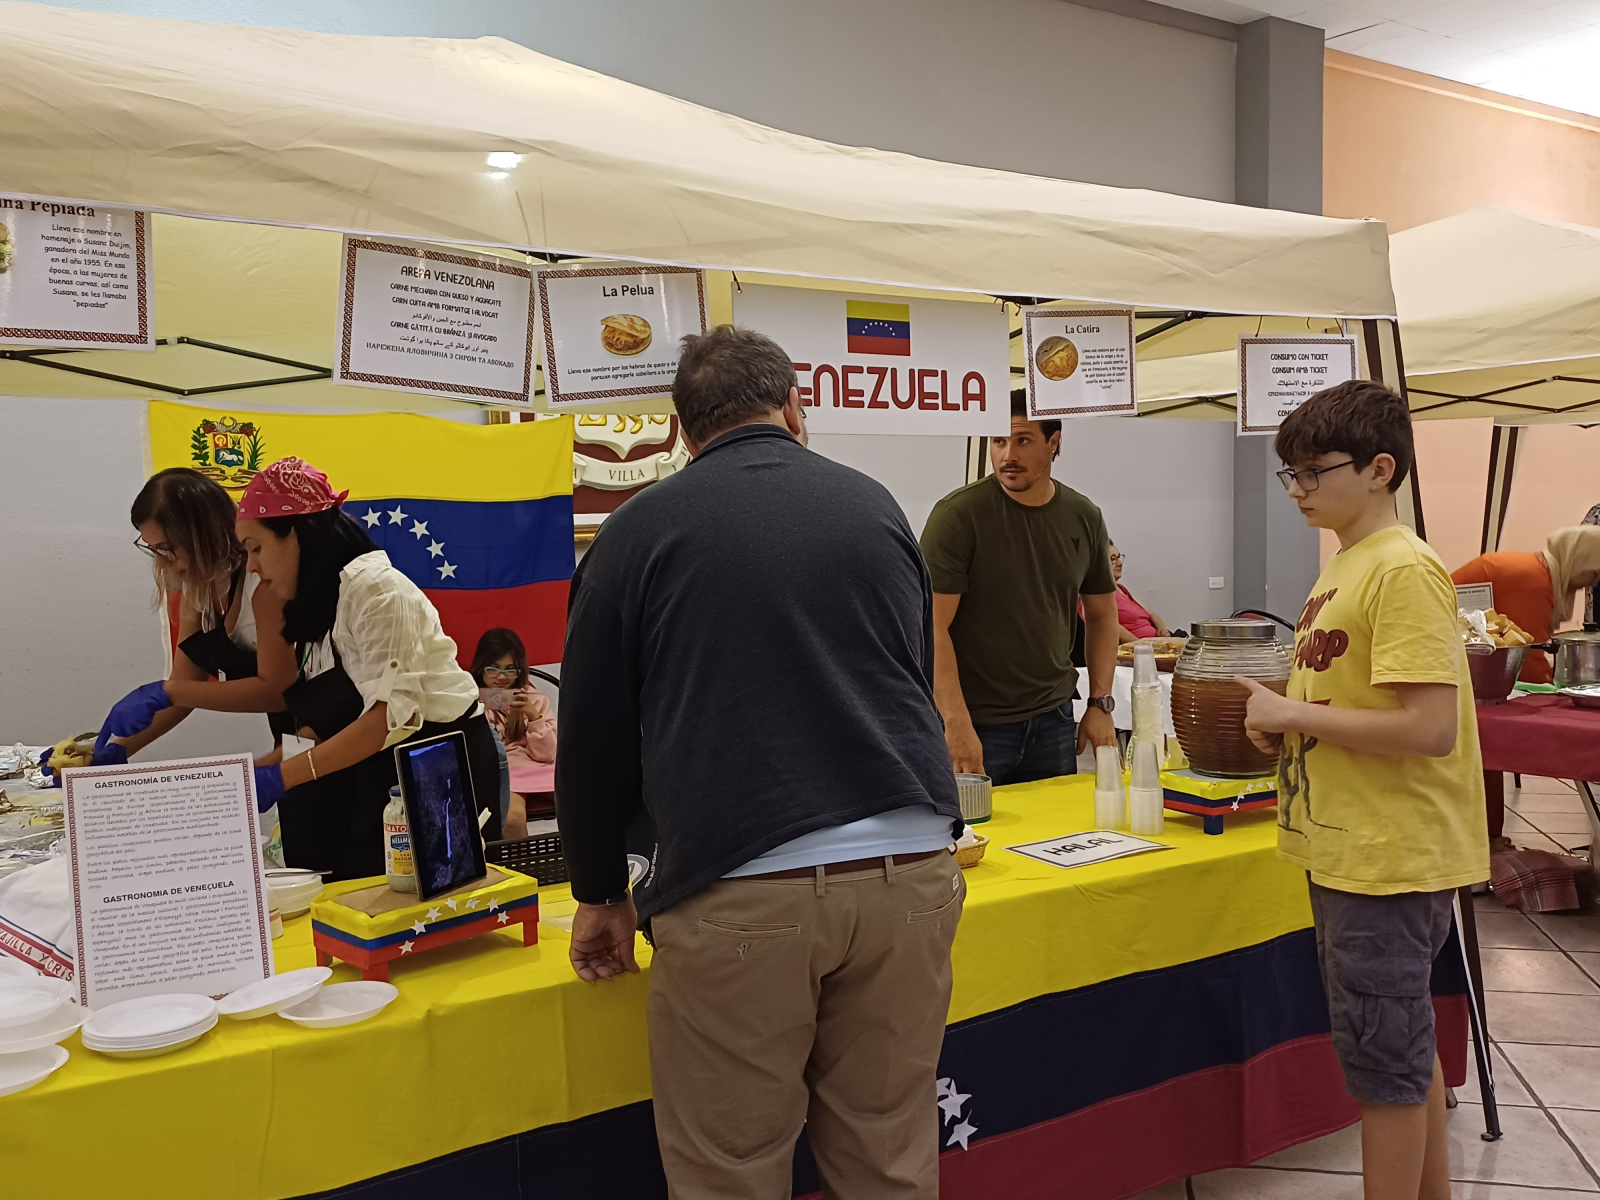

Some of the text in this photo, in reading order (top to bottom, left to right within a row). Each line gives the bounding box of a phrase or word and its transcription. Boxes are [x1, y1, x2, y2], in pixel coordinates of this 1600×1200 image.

[30, 201, 95, 217] Pepiada
[52, 224, 71, 232] Lleva
[86, 228, 112, 236] nombre
[41, 234, 76, 244] homenaje
[84, 238, 108, 246] Susana
[84, 258, 102, 266] 1955.
[400, 266, 494, 290] AREPA VENEZOLANA
[52, 288, 79, 296] Susana,
[103, 292, 126, 300] llamaba
[390, 282, 409, 292] CARNE
[410, 286, 438, 296] MECHADA
[452, 292, 468, 301] QUESO
[475, 296, 502, 307] AGUACATE
[602, 284, 654, 298] La Pelua
[392, 296, 408, 304] CARN
[409, 298, 426, 307] CUITA
[427, 301, 440, 310] AMB
[442, 304, 470, 314] FORMATGE
[474, 309, 498, 319] ALVOCAT
[390, 320, 409, 330] CARNE
[473, 333, 498, 342] AVOCADO
[1065, 324, 1100, 334] La Catira
[486, 358, 514, 368] АВОКАДО
[792, 362, 986, 412] ENEZUELA
[608, 468, 645, 482] VILLA
[94, 776, 158, 788] GASTRONOMÍA
[174, 770, 224, 781] VENEZUELA
[385, 824, 406, 832] MATO
[1042, 838, 1123, 856] HALAL
[103, 880, 234, 904] GASTRONOMIA DE VENEÇUELA
[38, 952, 50, 962] Y
[46, 960, 74, 982] CRIS
